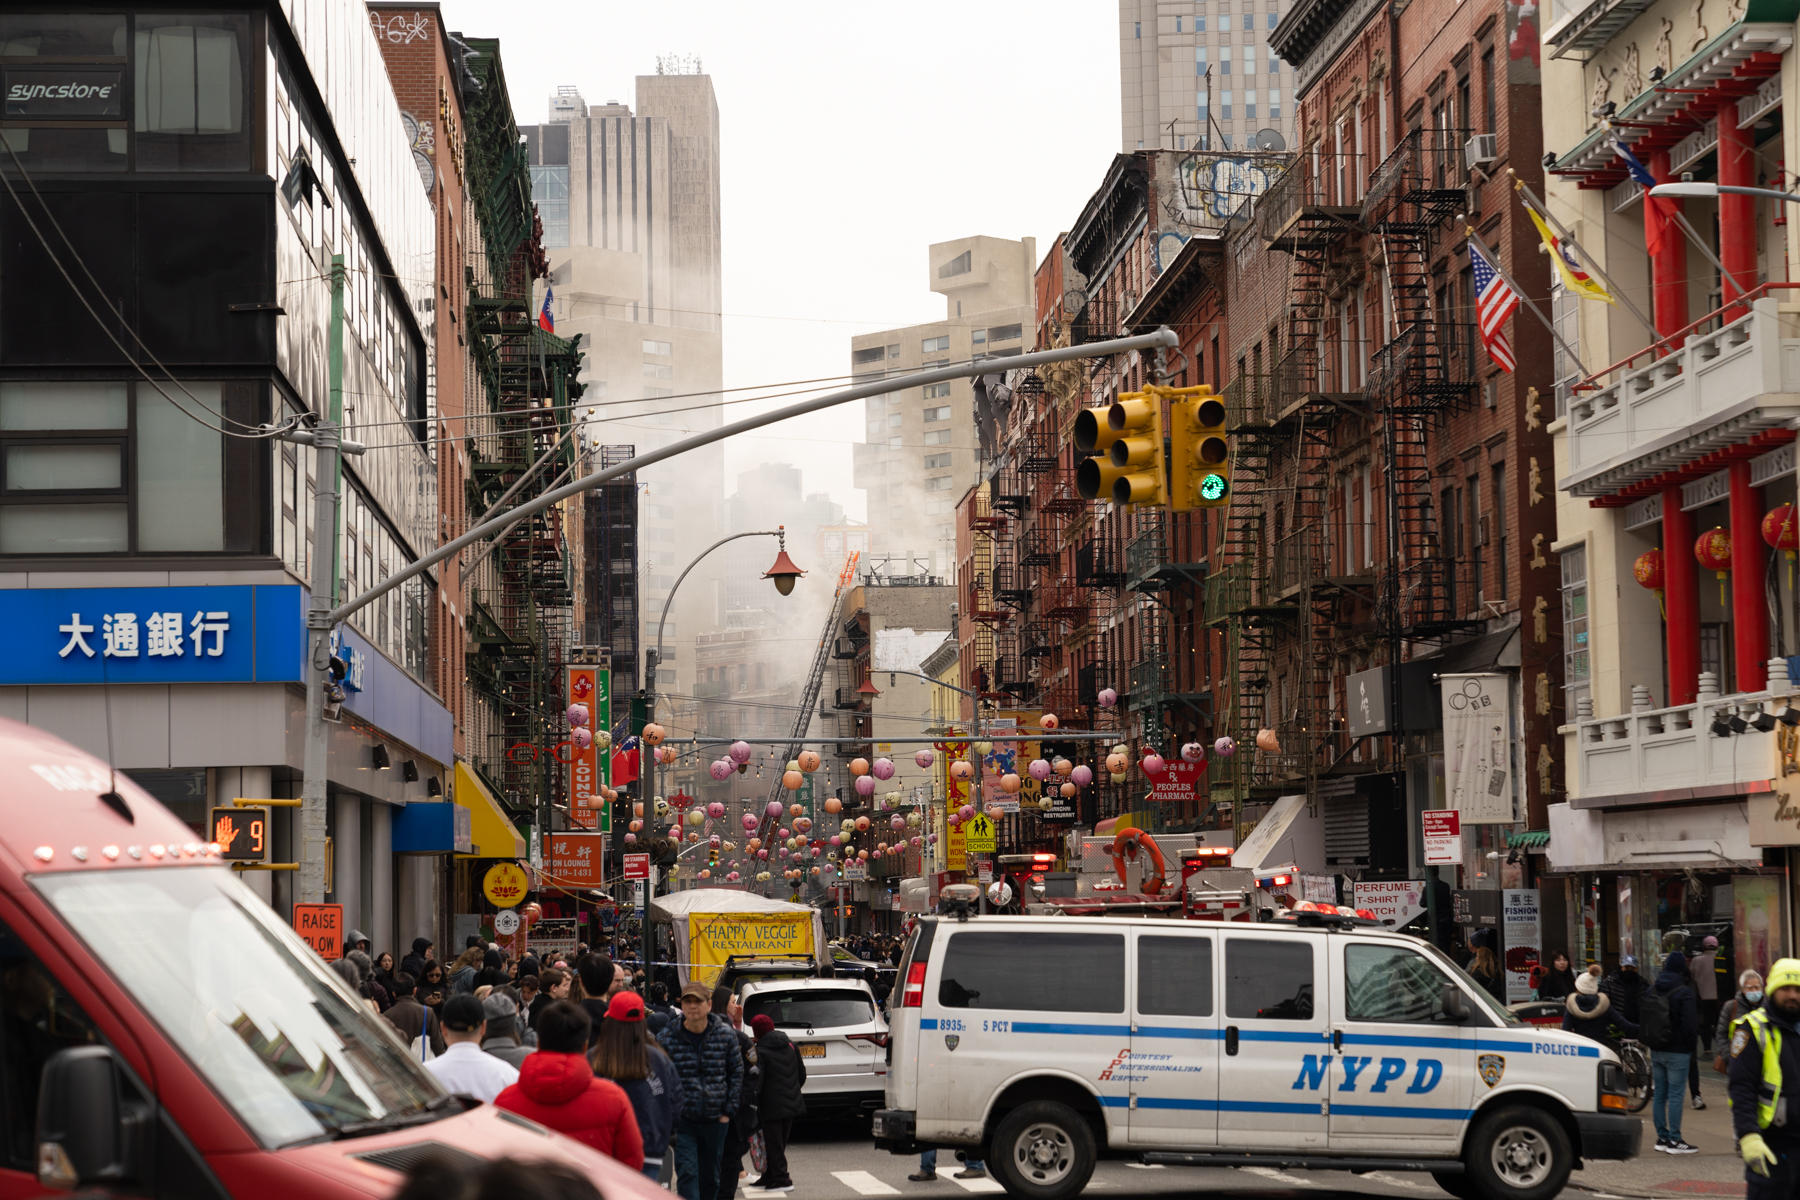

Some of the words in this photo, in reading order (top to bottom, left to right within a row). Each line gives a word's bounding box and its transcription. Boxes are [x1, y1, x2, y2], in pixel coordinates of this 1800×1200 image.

[7, 82, 112, 101] syncstore
[58, 611, 230, 658] 大通銀行
[1161, 763, 1195, 772] 安西藥房
[576, 759, 591, 807] LOUNGE
[1156, 783, 1191, 791] PEOPLES
[1152, 792, 1195, 800] PHARMACY
[250, 821, 263, 852] 9
[552, 842, 592, 860] 悅軒
[1270, 886, 1290, 895] 1621
[1356, 883, 1412, 892] PERFUME
[1357, 896, 1399, 904] T-SHIRT
[1505, 907, 1538, 915] FISHION
[302, 913, 336, 929] RAISE
[707, 926, 748, 940] HAPPY
[755, 926, 798, 940] VEGGIE
[712, 941, 794, 949] RESTAURANT
[940, 1019, 962, 1031] 8935
[983, 1020, 989, 1032] 5
[992, 1021, 1009, 1033] PCT
[1535, 1043, 1577, 1056] POLICE
[1098, 1070, 1148, 1082] RESPECT
[1291, 1054, 1443, 1095] NYPD
